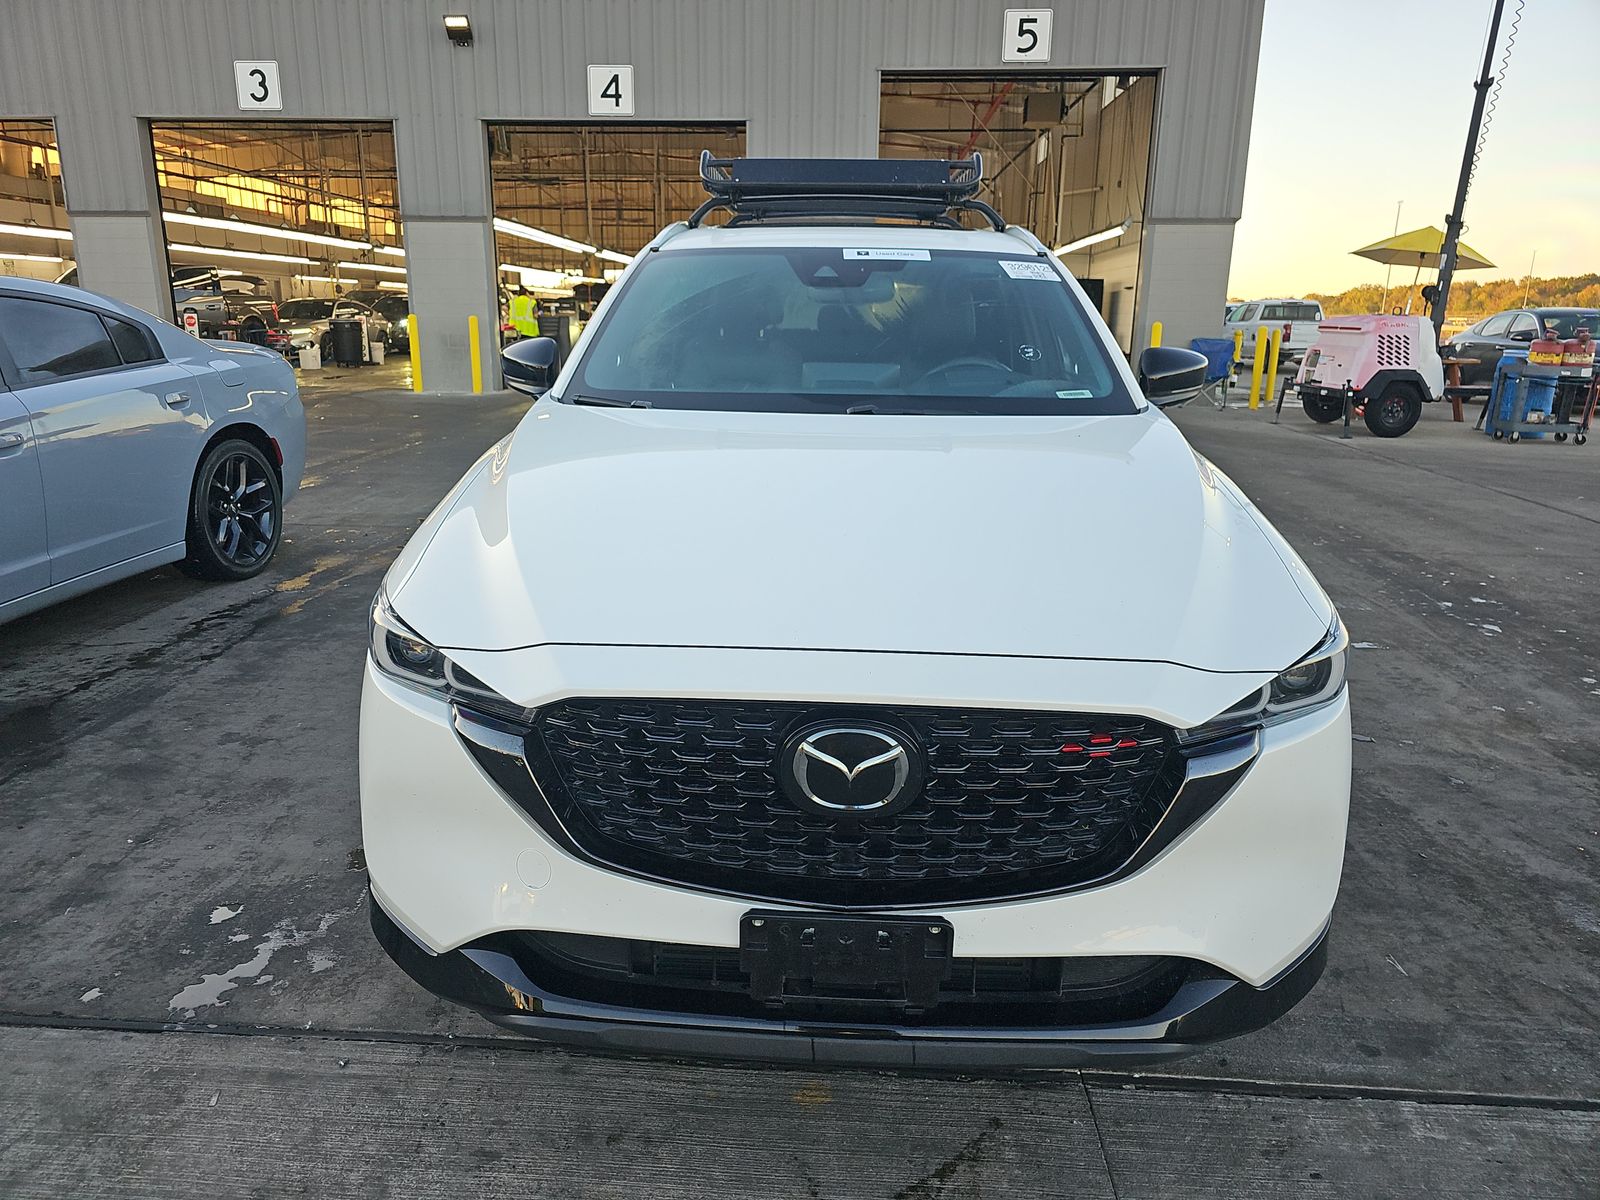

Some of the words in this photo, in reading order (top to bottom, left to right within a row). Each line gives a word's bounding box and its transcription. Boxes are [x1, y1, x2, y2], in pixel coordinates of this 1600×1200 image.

[1016, 17, 1038, 55] 5
[249, 68, 270, 103] 3
[600, 73, 622, 108] 4
